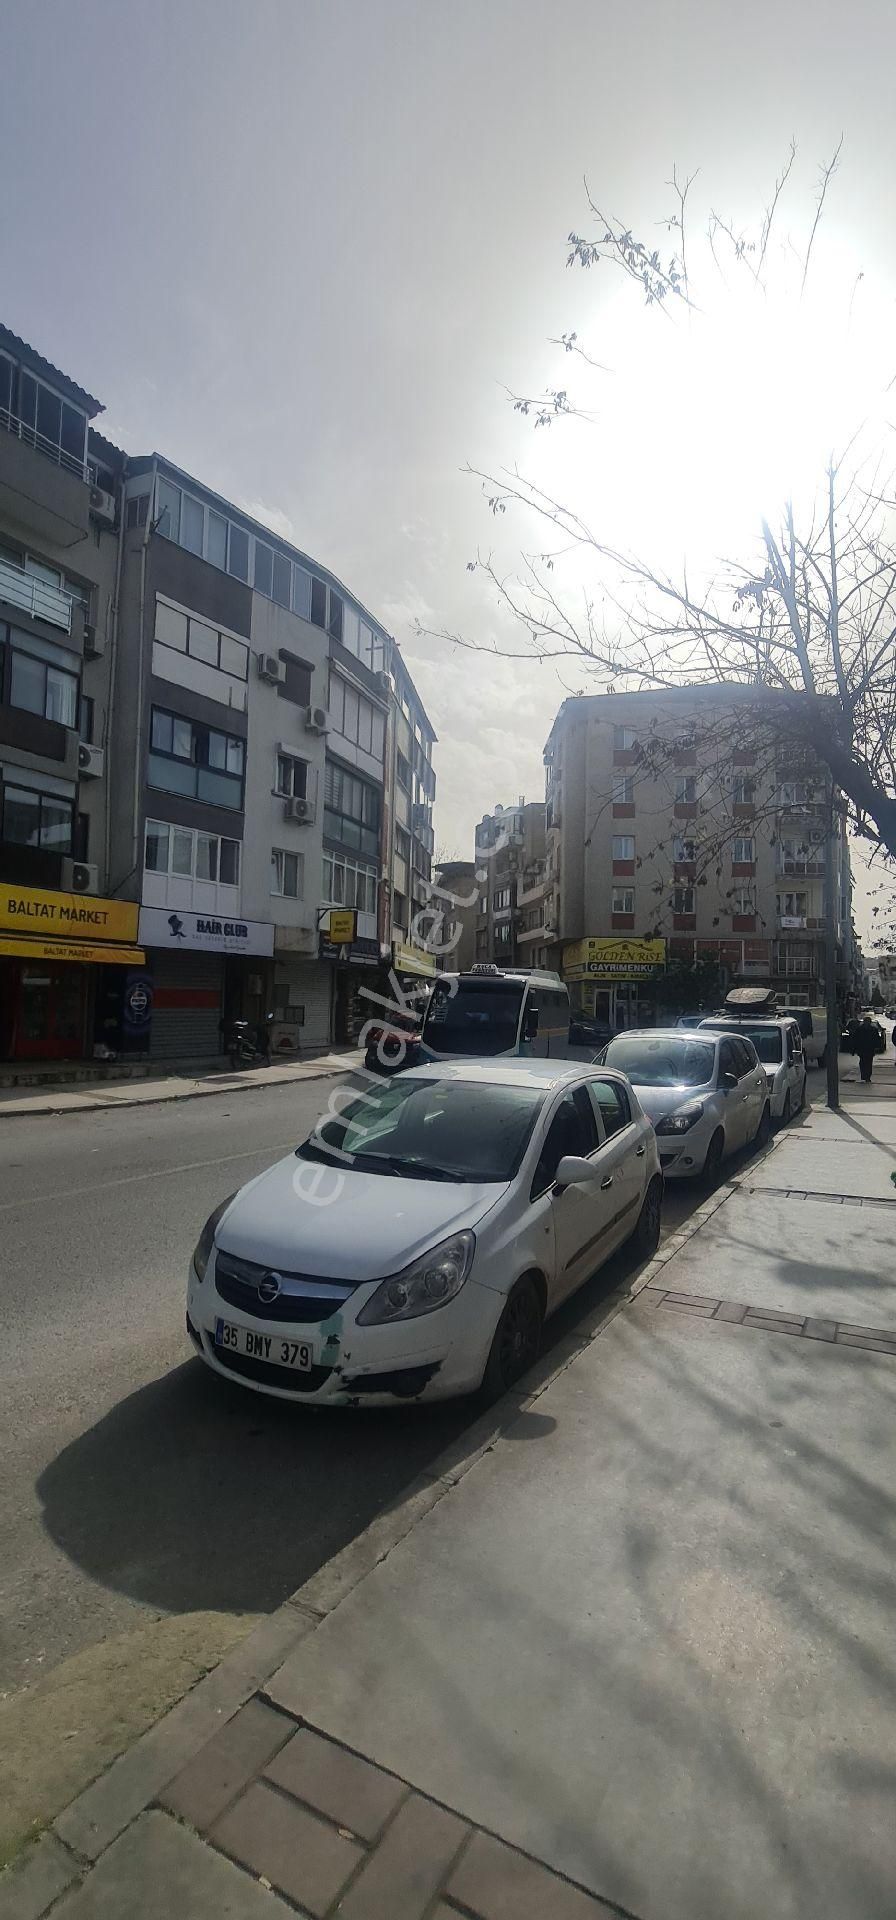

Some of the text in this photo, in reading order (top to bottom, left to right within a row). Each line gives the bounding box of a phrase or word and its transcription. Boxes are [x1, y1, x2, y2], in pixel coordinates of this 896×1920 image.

[8, 899, 109, 924] BALTAT MARKET
[224, 923, 248, 937] CLUB
[43, 947, 94, 958] BALTAT MARKET
[589, 952, 634, 961] GOLDEN
[223, 1325, 309, 1367] 35 BMY 379
